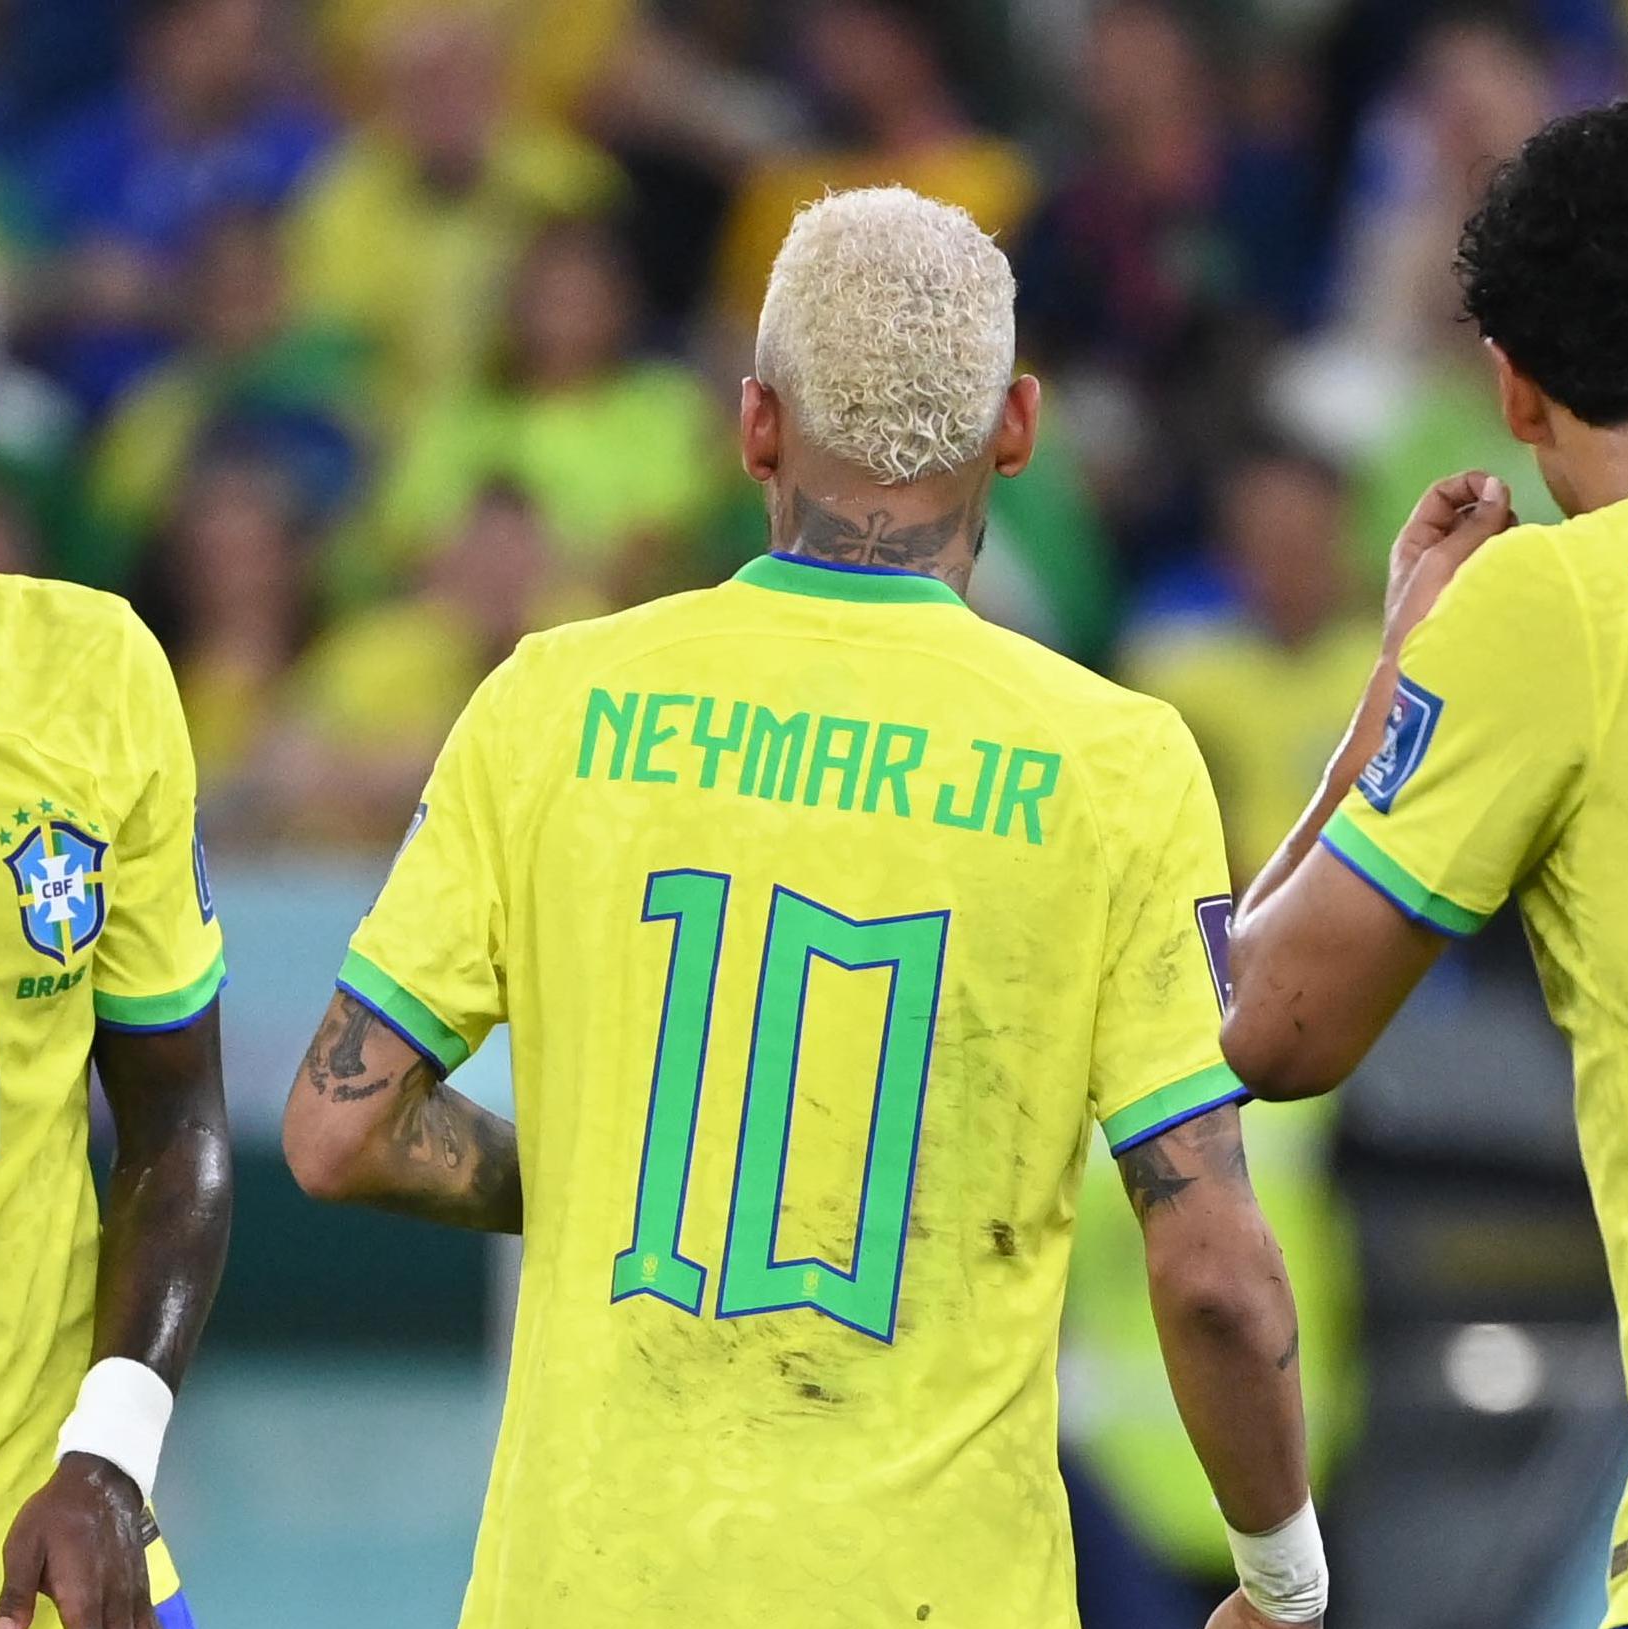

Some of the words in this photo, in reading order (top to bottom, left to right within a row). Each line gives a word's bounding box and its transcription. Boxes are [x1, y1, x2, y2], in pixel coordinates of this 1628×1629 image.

[575, 687, 928, 819] NEYMAR
[932, 738, 1062, 846] JR
[42, 878, 73, 899] CBF
[610, 868, 951, 1345] 10
